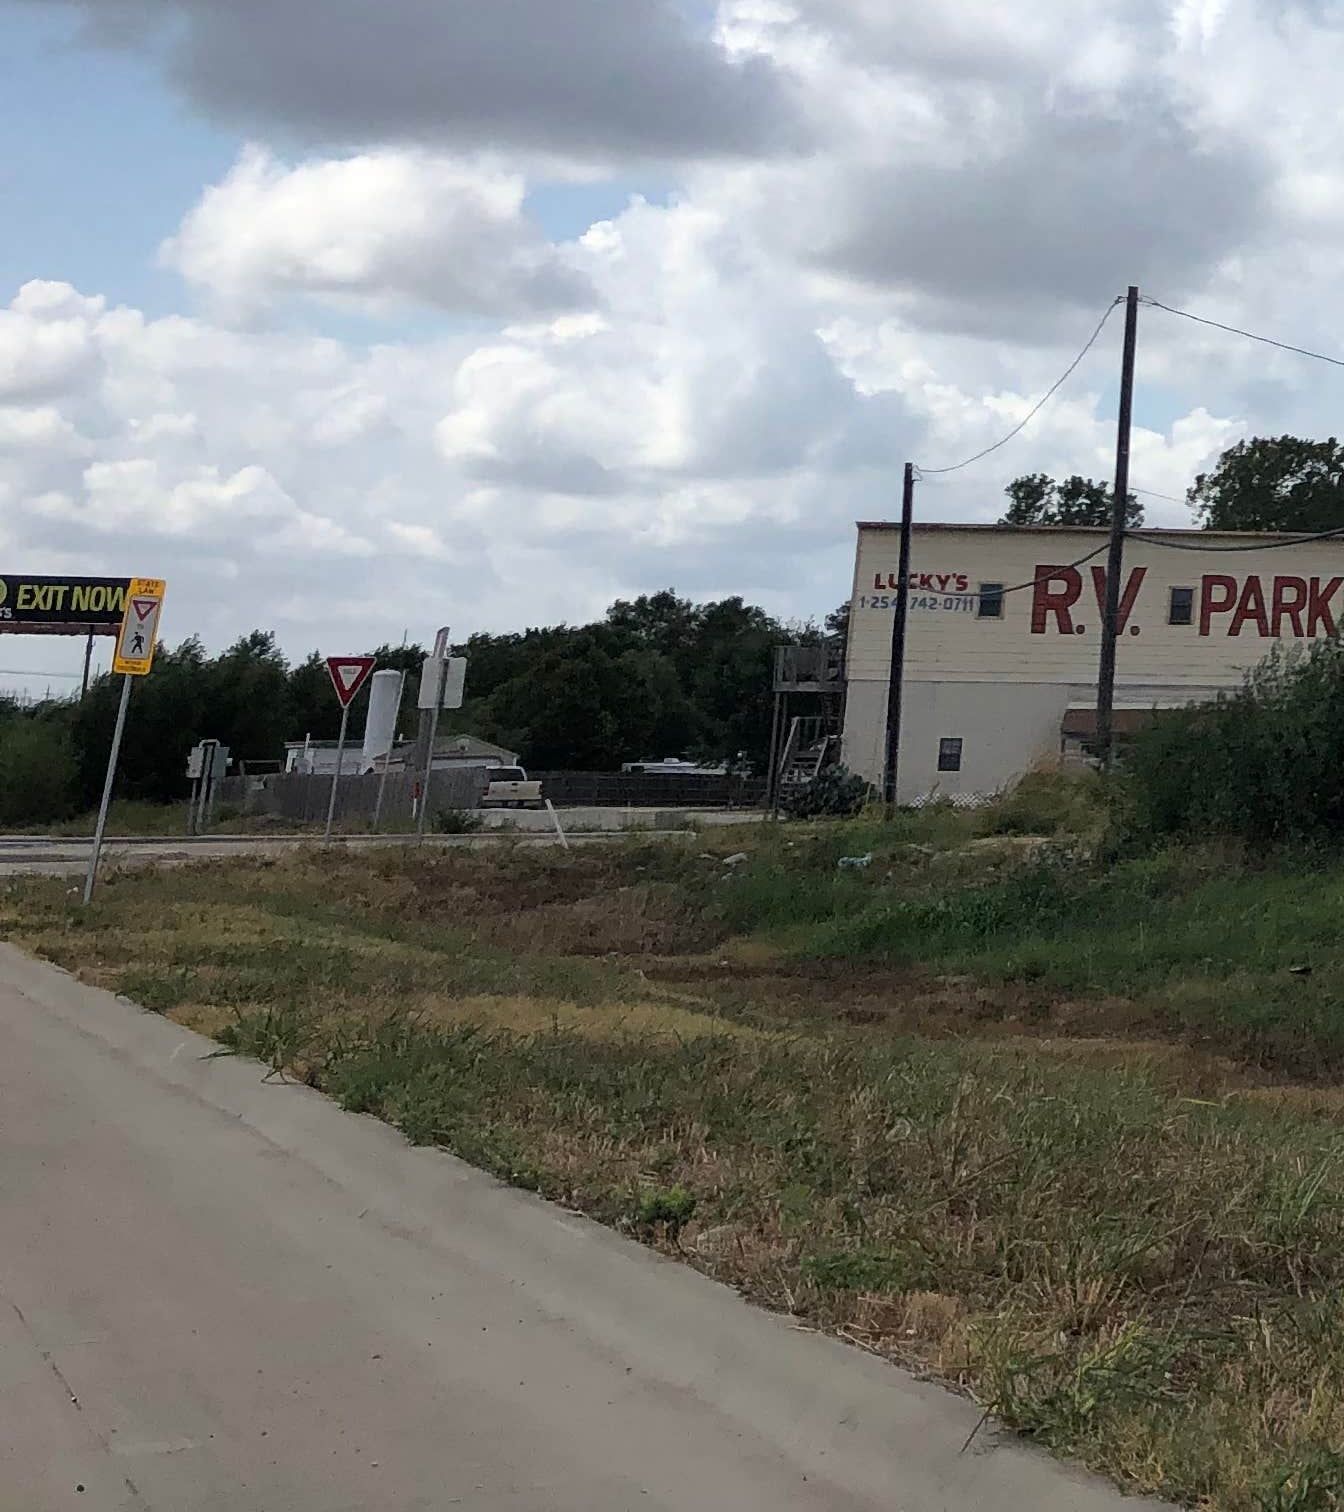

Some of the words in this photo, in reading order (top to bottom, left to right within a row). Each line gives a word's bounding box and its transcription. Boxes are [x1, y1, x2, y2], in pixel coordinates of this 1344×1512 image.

[874, 573, 969, 591] LUCKY'S
[16, 584, 69, 610] EXIT
[70, 585, 125, 611] NOW
[1199, 574, 1344, 637] PARK
